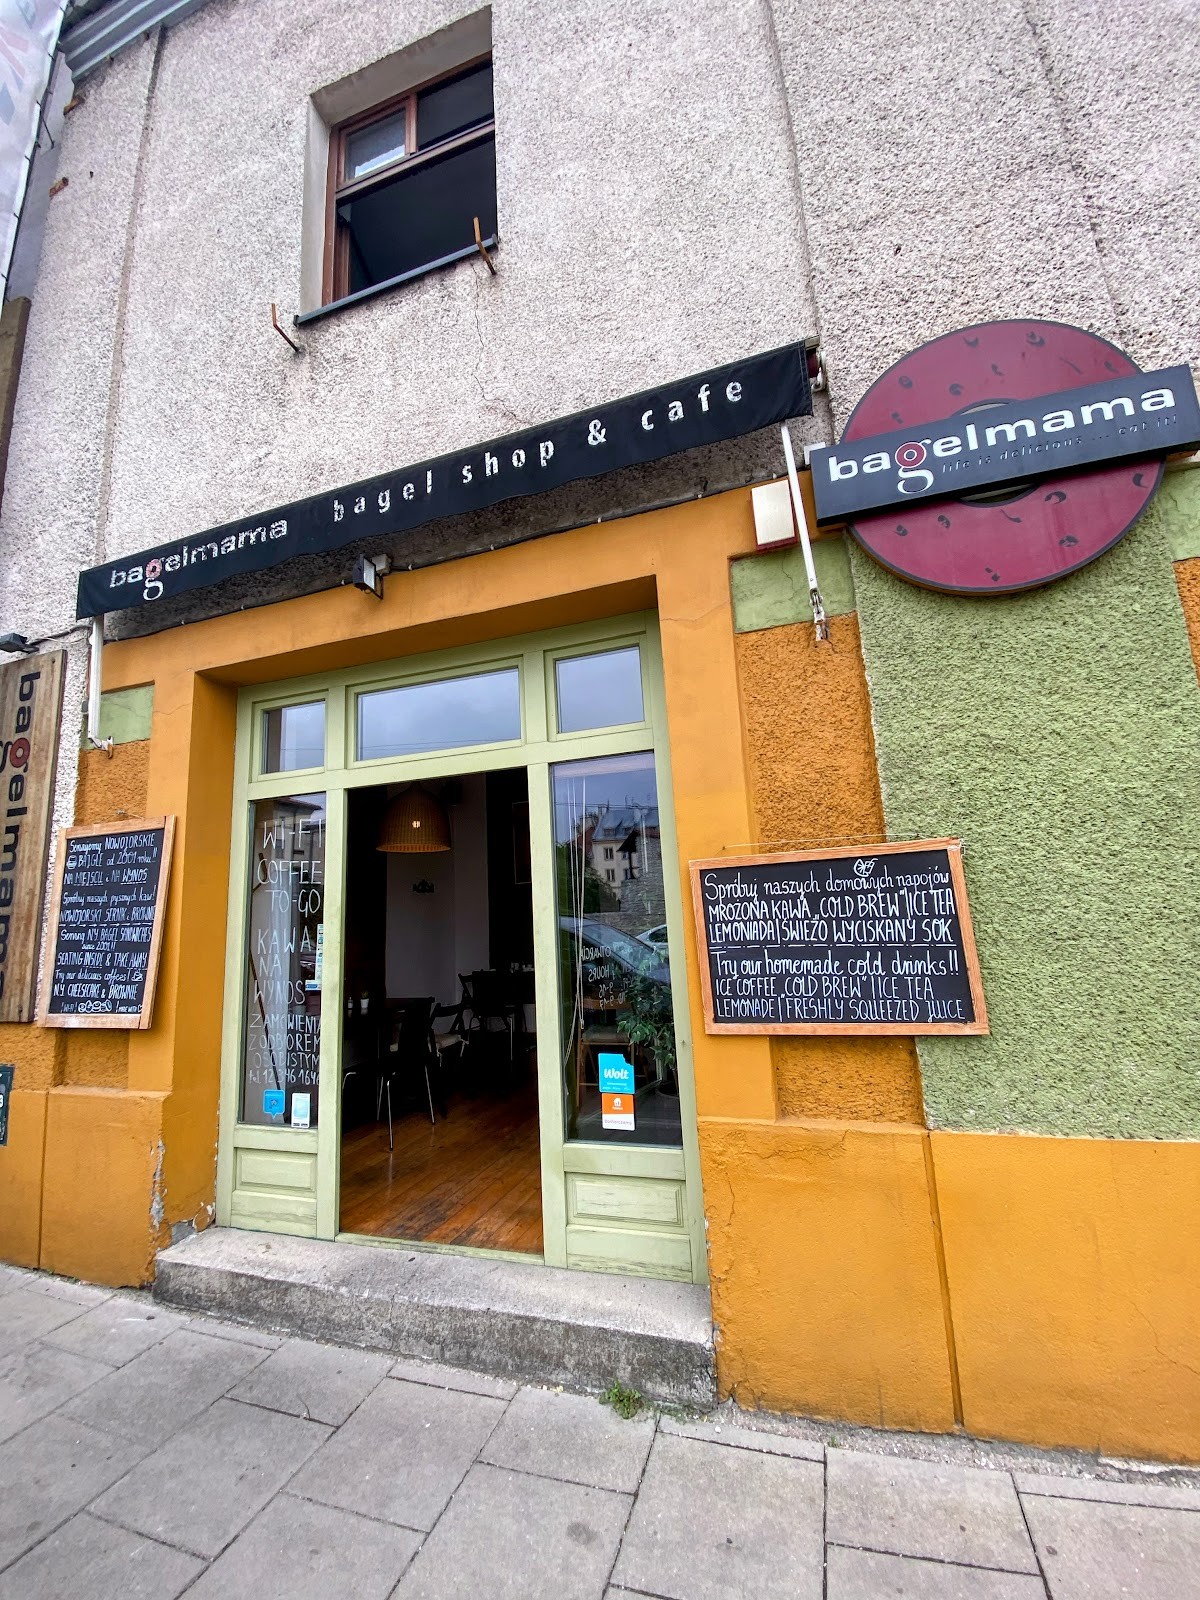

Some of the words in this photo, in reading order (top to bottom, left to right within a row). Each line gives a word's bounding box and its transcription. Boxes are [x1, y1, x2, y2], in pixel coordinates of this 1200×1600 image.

[828, 386, 1177, 494] bagelmama
[942, 459, 971, 473] life
[978, 454, 992, 466] is
[999, 435, 1083, 461] delicious
[1118, 421, 1148, 436] eat
[1156, 414, 1178, 428] it!
[109, 517, 288, 600] bagelmama
[333, 469, 433, 522] bagel
[462, 439, 555, 484] shop
[587, 418, 608, 446] &
[641, 379, 743, 431] cafe
[0, 671, 41, 996] bagelmam
[263, 818, 322, 849] WI-FI
[107, 853, 115, 866] od
[116, 850, 137, 865] 2001
[257, 858, 323, 886] COFFEE
[63, 872, 74, 885] NA
[121, 867, 149, 883] WYNOS
[704, 871, 759, 905] Spróbuj
[763, 869, 821, 901] naszych
[825, 864, 894, 898] domowych
[896, 865, 950, 895] napojów
[265, 888, 321, 918] TO-GO
[771, 897, 811, 919] KAWA
[929, 887, 956, 915] TEA
[257, 925, 312, 955] KAWA
[832, 919, 916, 942] WYCISKANY
[922, 917, 954, 942] SOK
[57, 951, 83, 966] SEATING
[259, 953, 282, 978] NA
[710, 950, 739, 980] Try
[740, 959, 763, 975] our
[764, 948, 844, 975] homemade
[847, 950, 886, 976] cold
[254, 979, 306, 1005] WYNOS
[715, 978, 733, 996] ICE
[736, 976, 778, 997] COFFEE
[903, 976, 935, 1000] TEA
[716, 998, 776, 1018] LEMONADE
[785, 997, 844, 1020] FRESHLY
[848, 998, 920, 1021] SQUEEZED
[924, 999, 966, 1022] JUICE
[603, 1067, 630, 1080] Wolt
